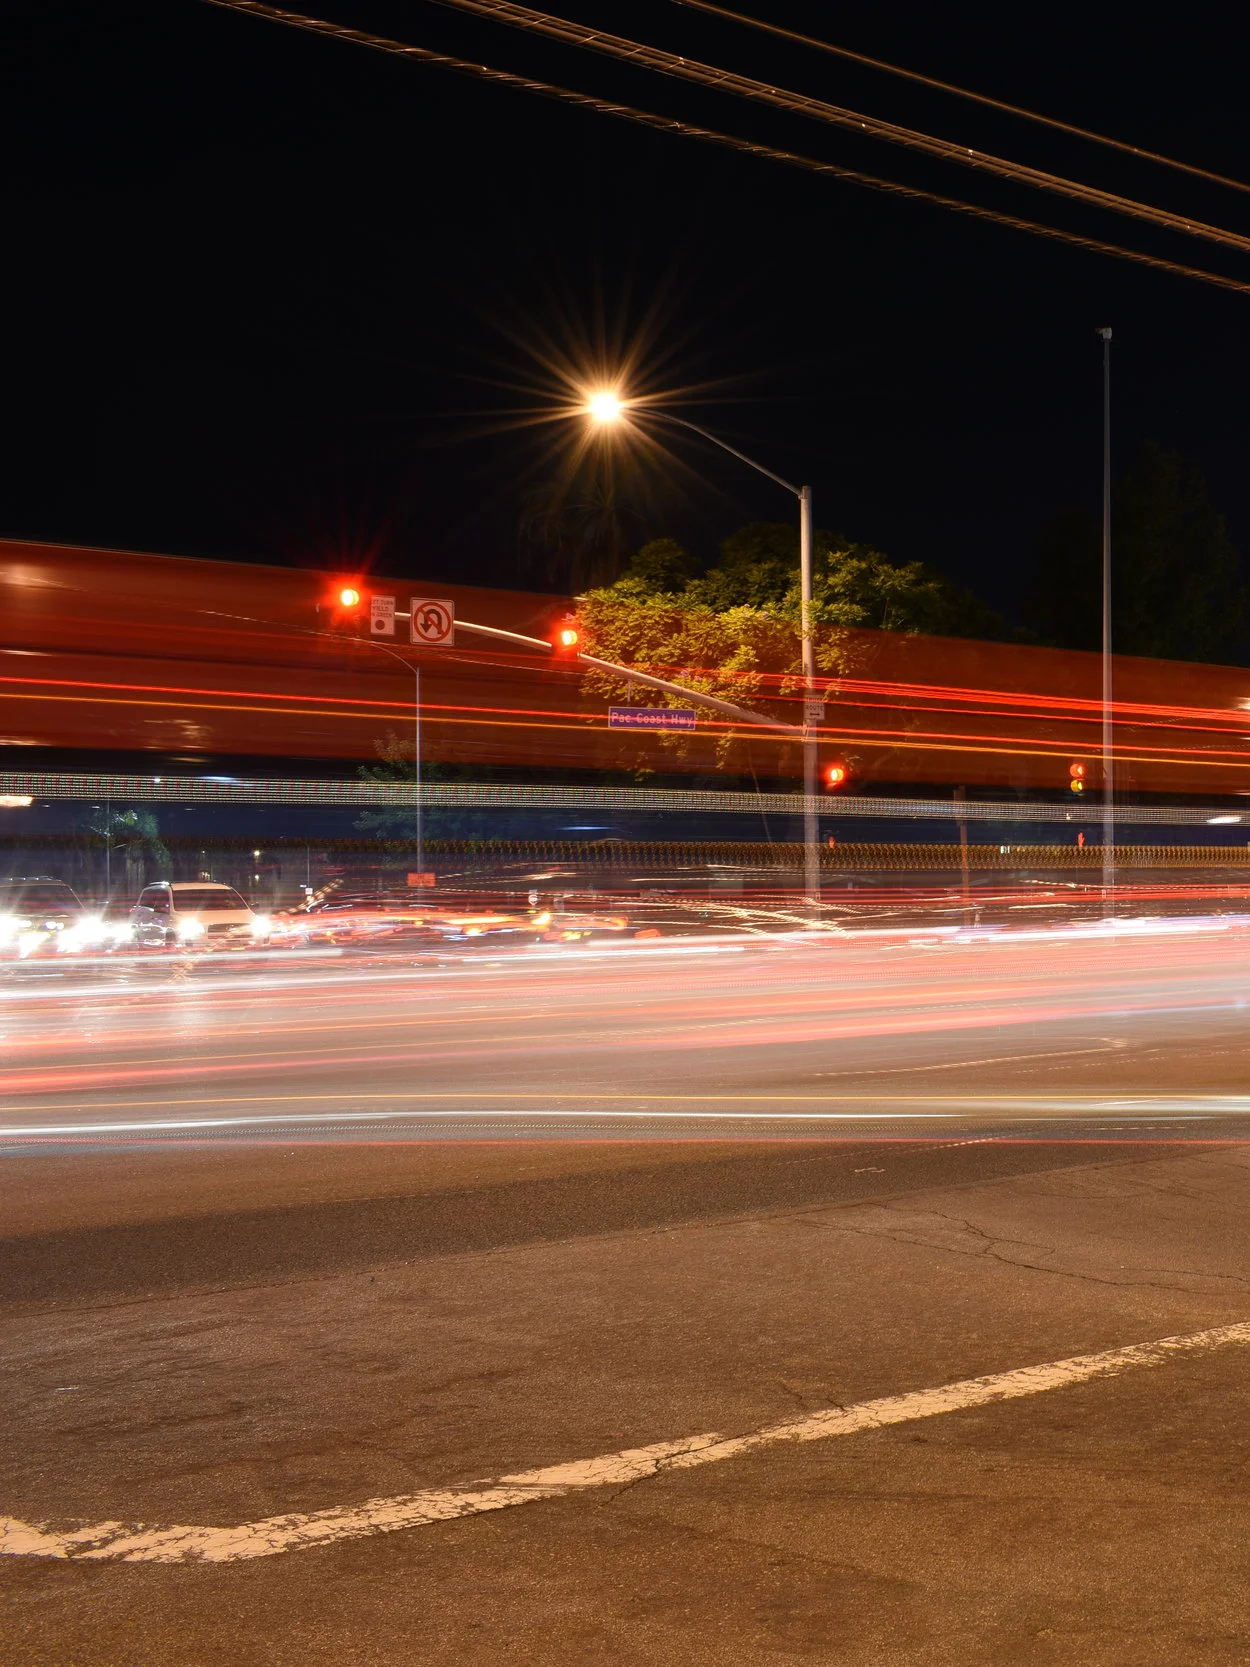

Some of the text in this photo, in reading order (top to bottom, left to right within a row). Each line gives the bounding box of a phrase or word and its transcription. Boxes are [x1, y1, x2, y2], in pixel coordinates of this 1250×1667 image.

[611, 711, 693, 727] Pac. Coast Hwy
